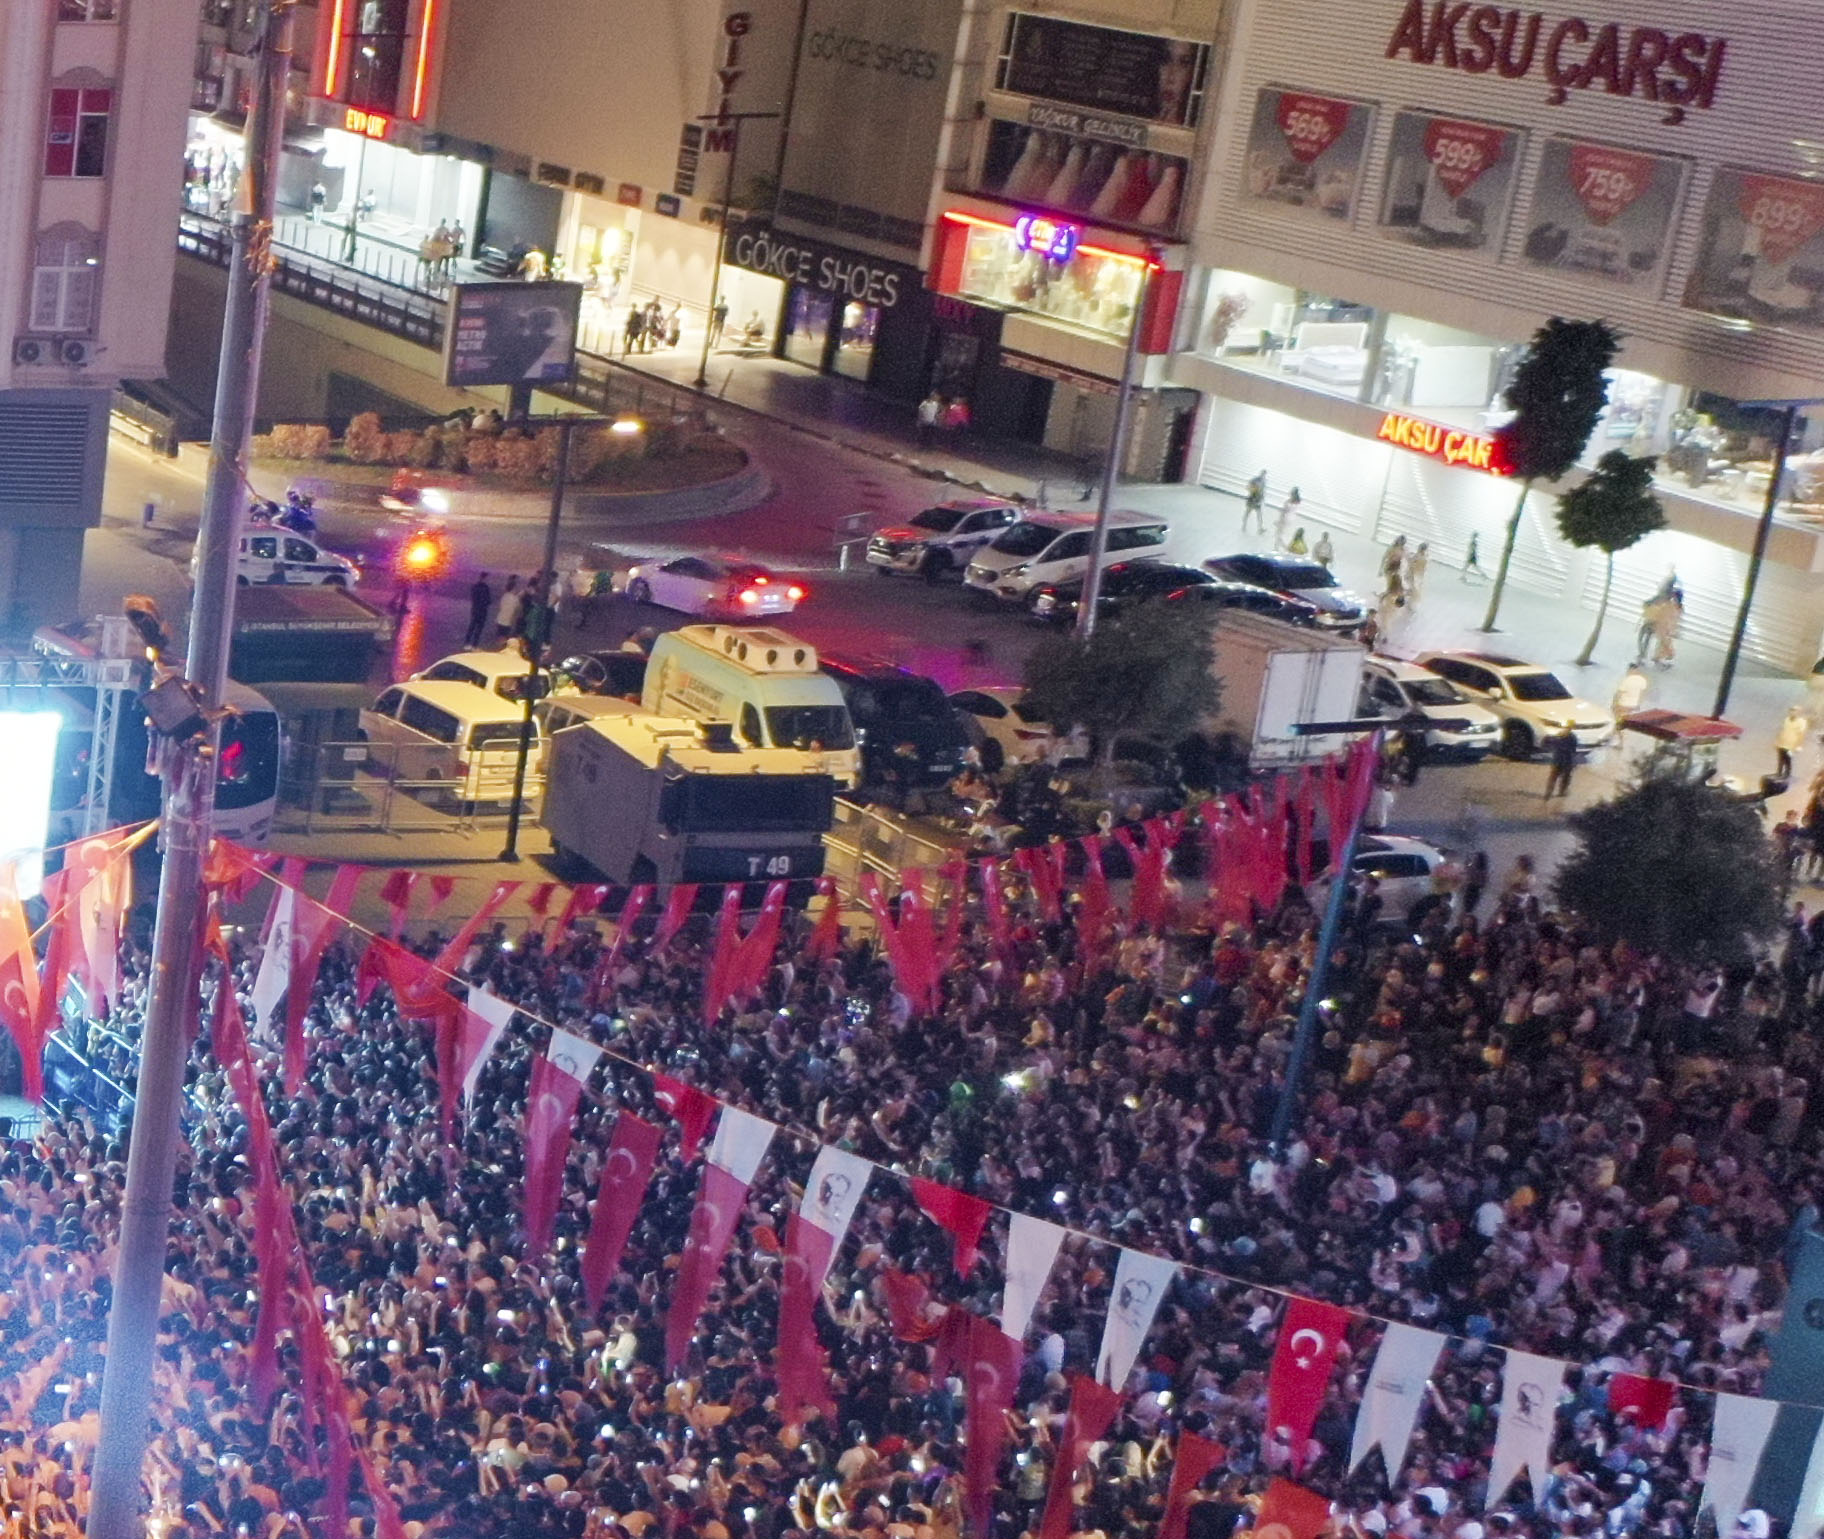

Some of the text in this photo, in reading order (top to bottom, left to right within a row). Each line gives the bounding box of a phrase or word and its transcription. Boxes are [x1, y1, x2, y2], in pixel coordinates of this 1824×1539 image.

[1384, 0, 1727, 126] AKSU ÇARŞI
[818, 257, 901, 307] SHOES
[1378, 412, 1441, 453] AKSU
[747, 855, 790, 877] T 49
